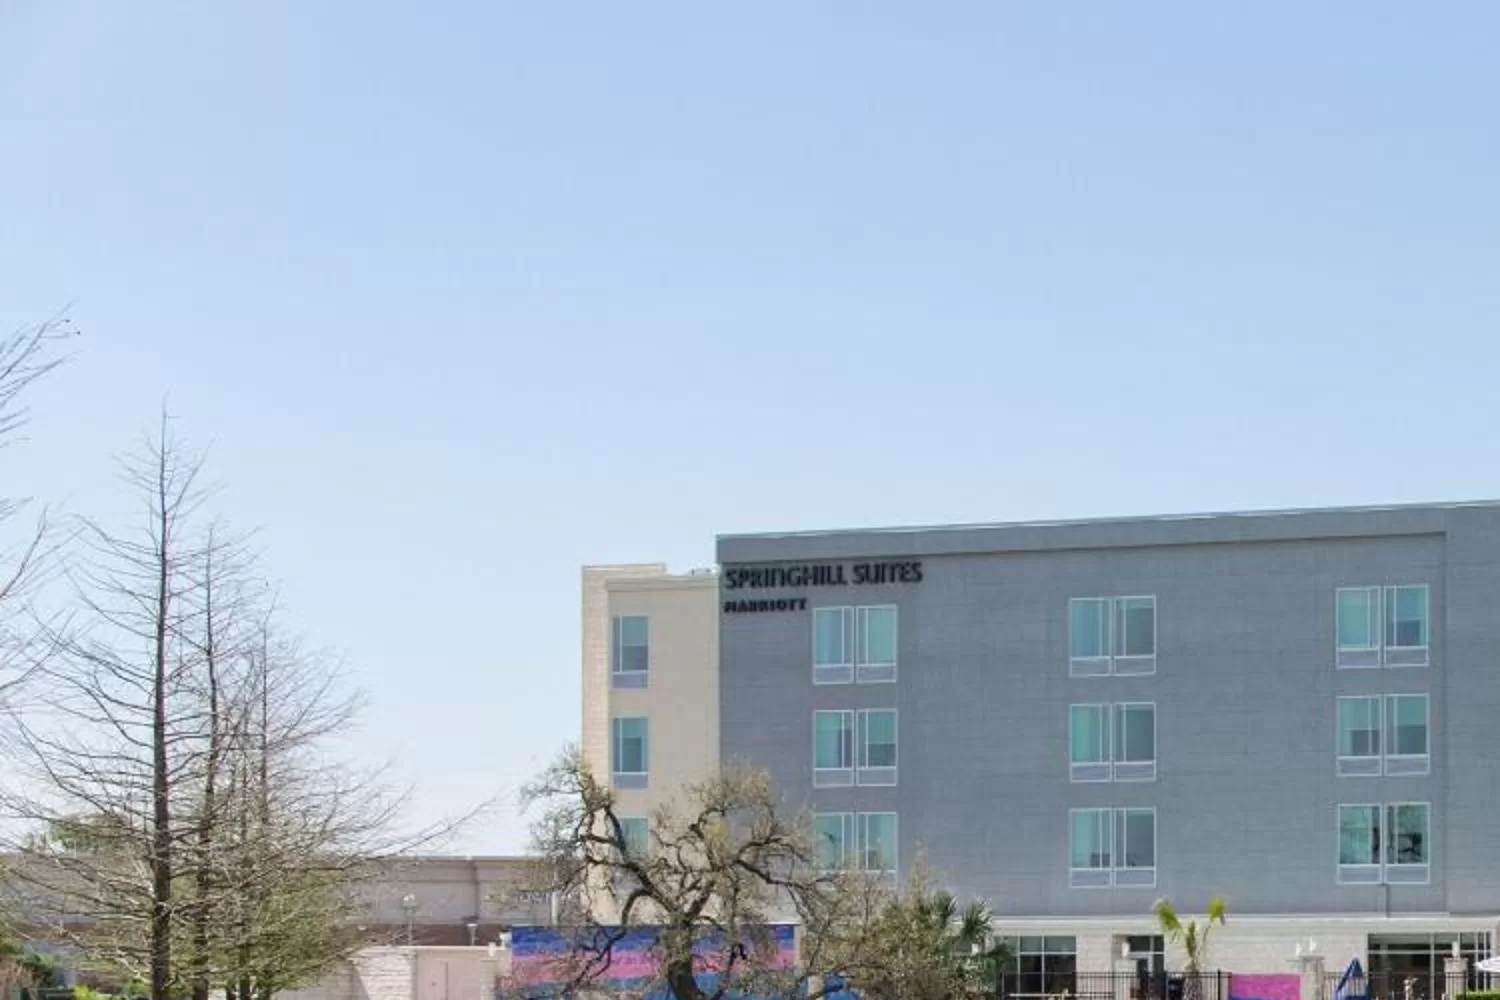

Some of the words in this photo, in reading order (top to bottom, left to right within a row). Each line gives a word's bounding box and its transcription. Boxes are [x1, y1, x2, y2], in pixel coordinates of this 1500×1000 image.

[725, 564, 848, 589] SPRINGHILL
[852, 561, 923, 584] SUITES
[724, 598, 807, 613] MARRIOTT
